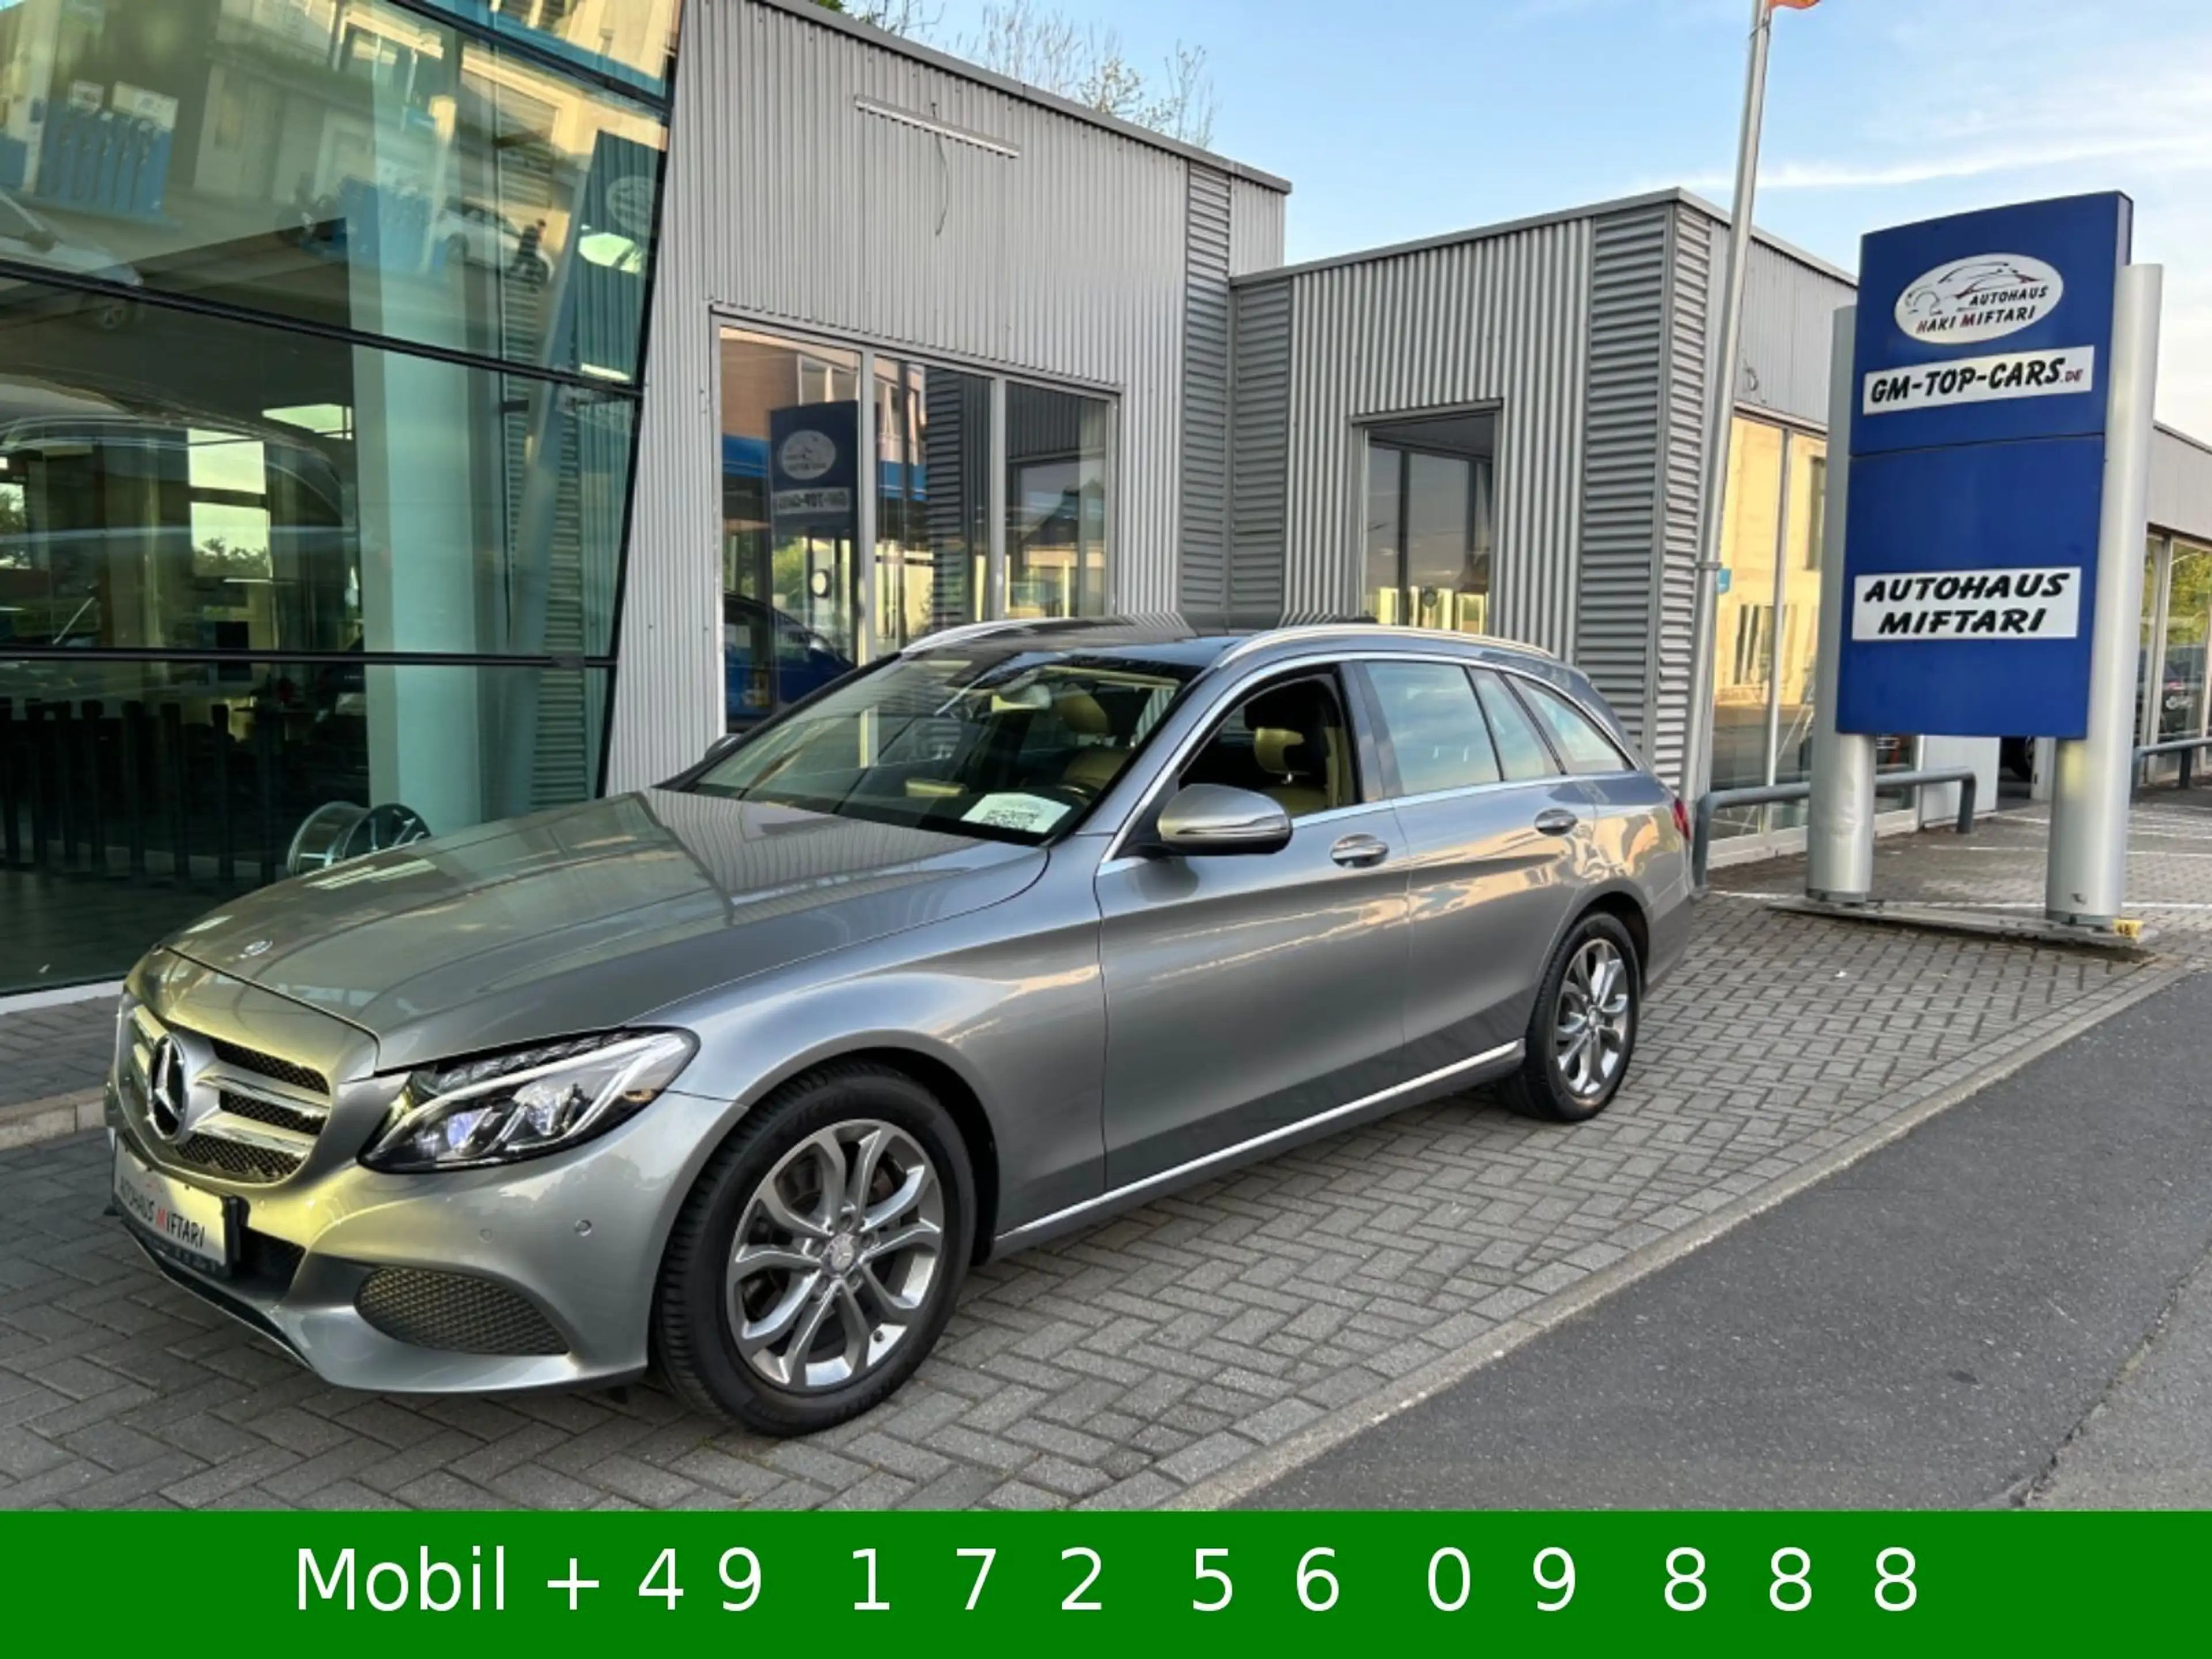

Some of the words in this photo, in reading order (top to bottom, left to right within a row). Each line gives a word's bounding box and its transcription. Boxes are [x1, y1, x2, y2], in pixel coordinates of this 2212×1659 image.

[1968, 285, 2049, 306] AUTOHAUS
[1915, 315, 1956, 334] HAKI
[1959, 305, 2036, 328] MIFTARI
[1863, 573, 2070, 603] AUTOHAUS
[1878, 608, 2046, 635] MIFTARI
